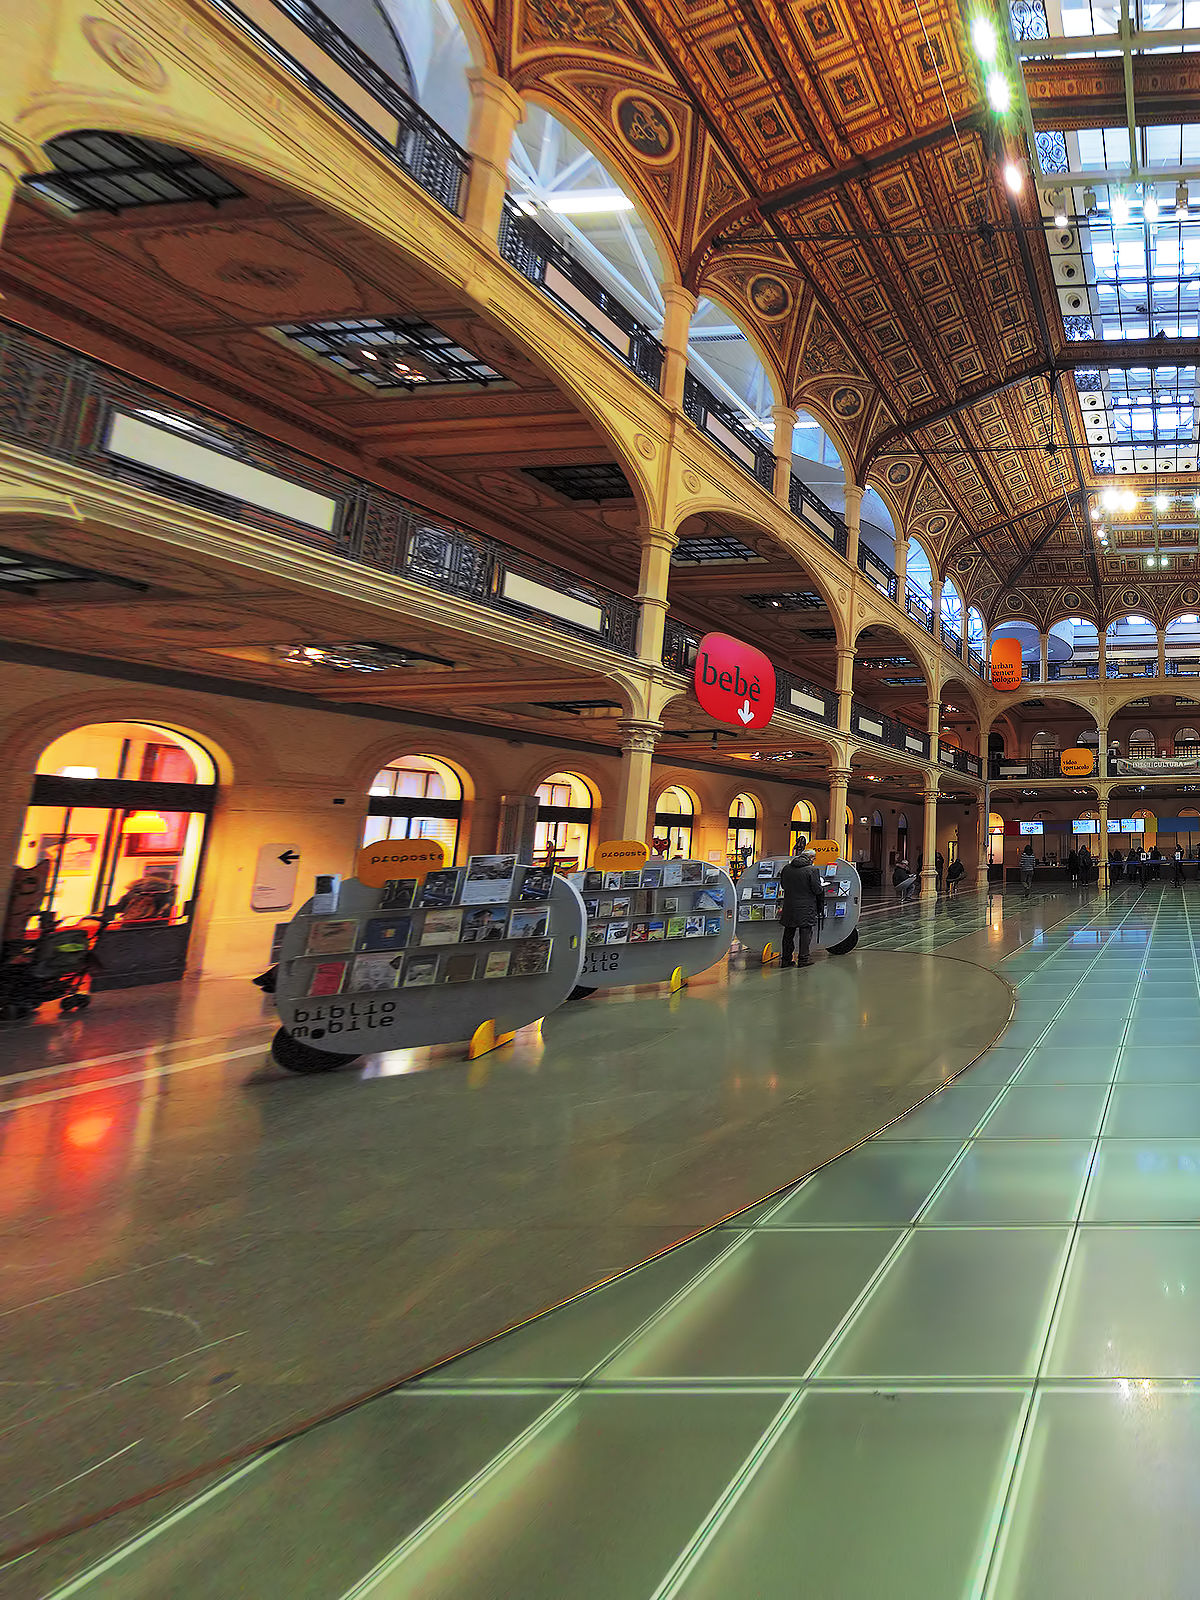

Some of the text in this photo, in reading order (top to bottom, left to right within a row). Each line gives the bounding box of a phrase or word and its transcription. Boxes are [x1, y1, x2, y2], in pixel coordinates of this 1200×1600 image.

[702, 652, 760, 702] bebè
[992, 676, 1020, 684] bologna
[294, 1000, 396, 1023] biblio
